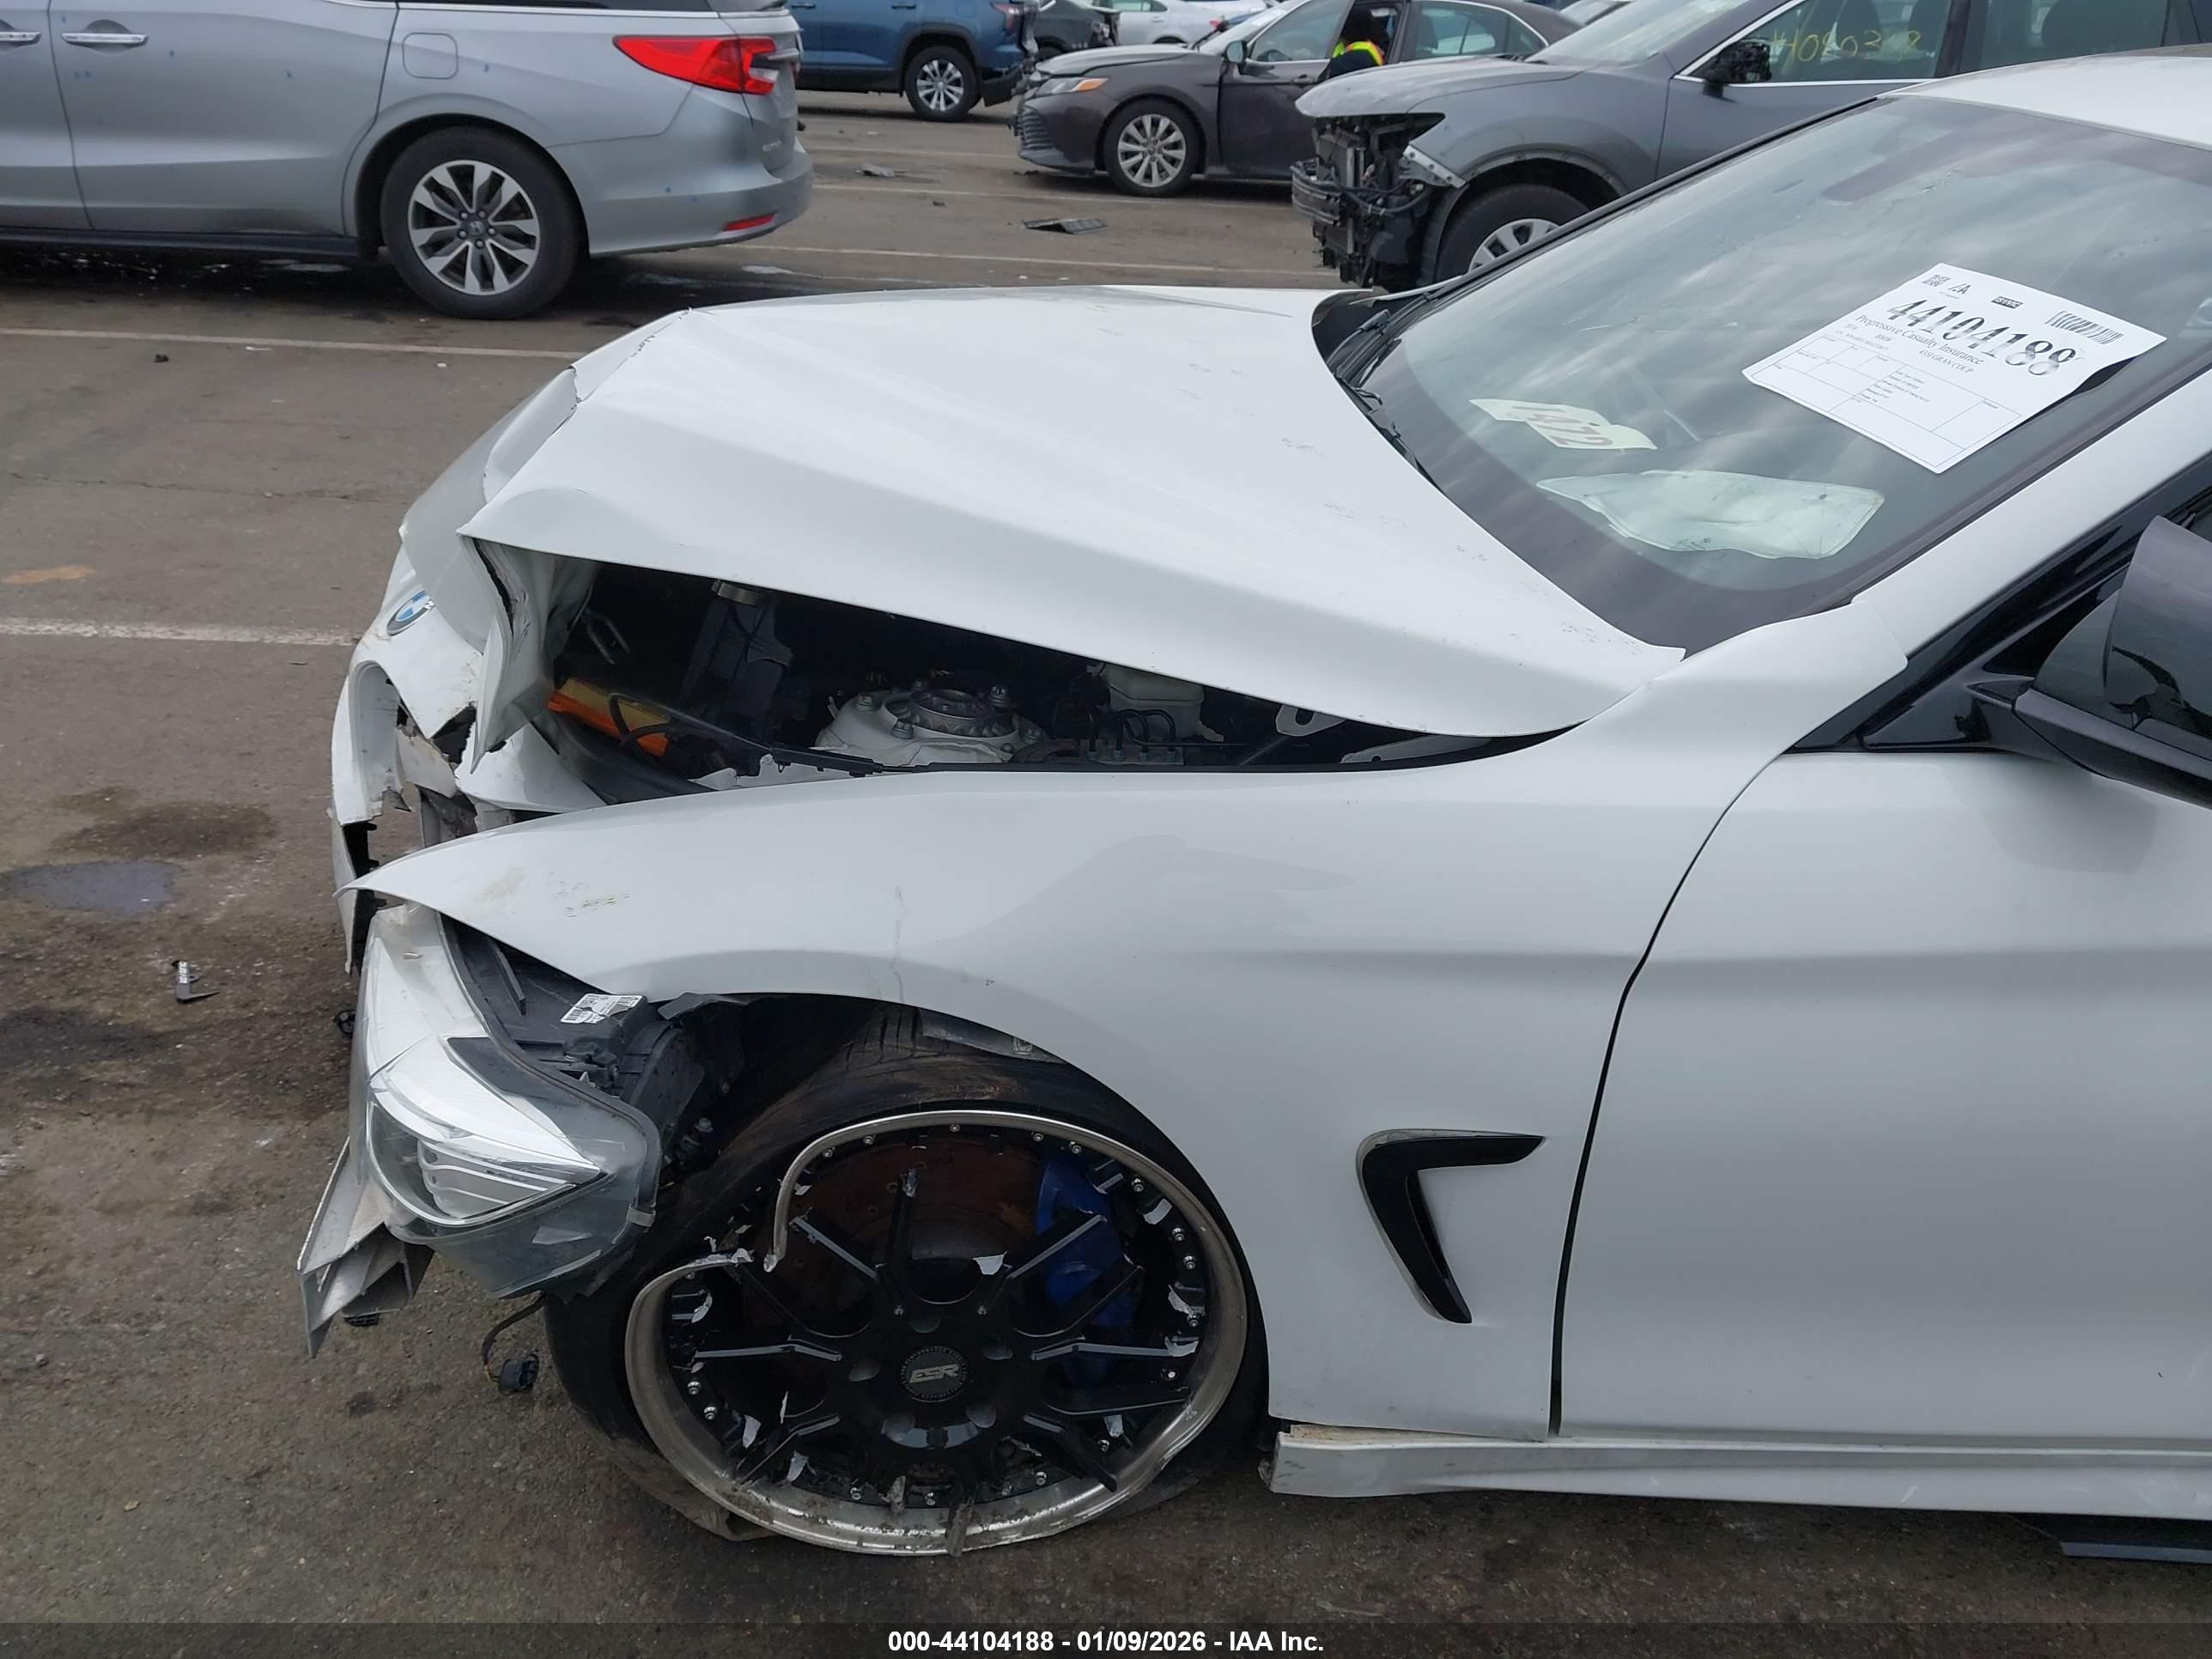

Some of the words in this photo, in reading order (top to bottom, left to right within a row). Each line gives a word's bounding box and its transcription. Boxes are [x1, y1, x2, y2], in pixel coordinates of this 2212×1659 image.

[1856, 314, 1903, 335] Progressive
[1901, 330, 1939, 349] Casualty
[1938, 343, 1984, 366] Insurance
[1887, 299, 2077, 376] 44104188
